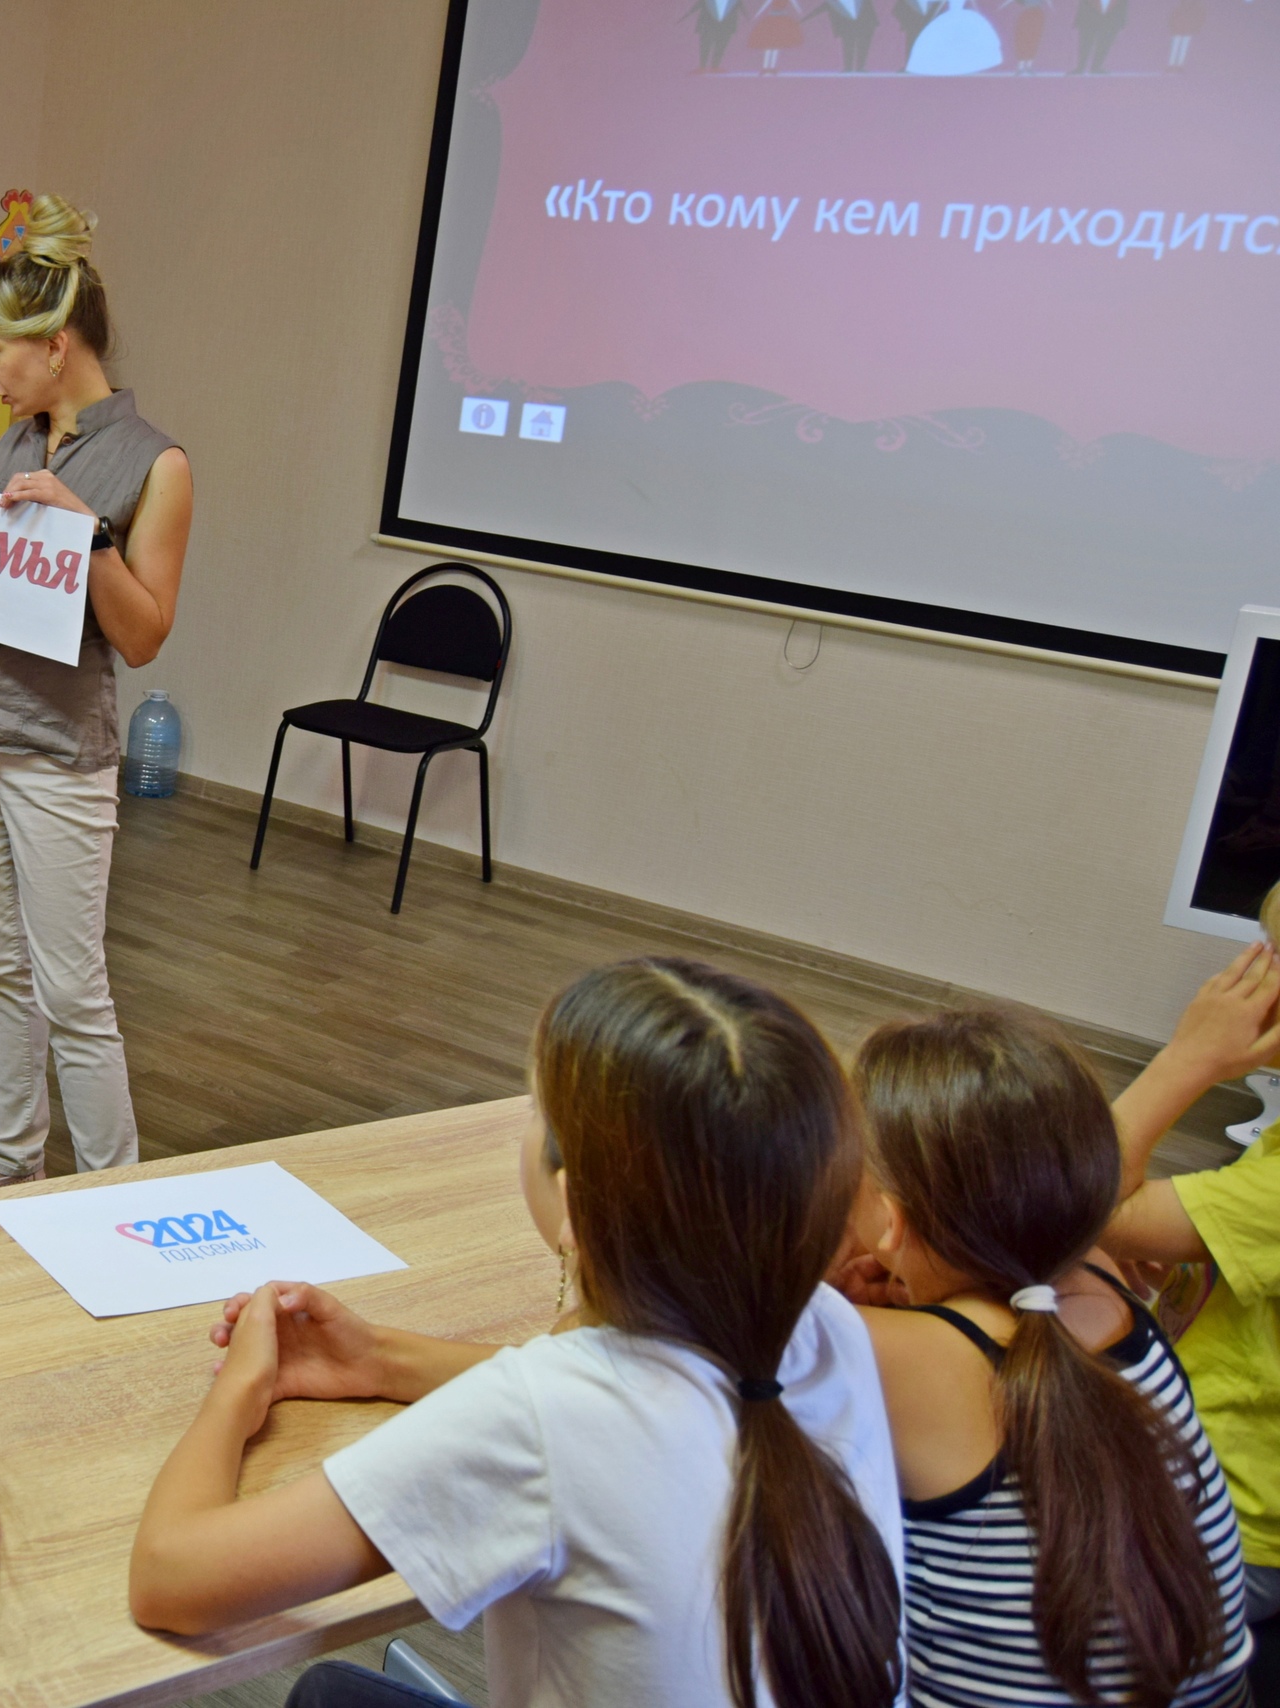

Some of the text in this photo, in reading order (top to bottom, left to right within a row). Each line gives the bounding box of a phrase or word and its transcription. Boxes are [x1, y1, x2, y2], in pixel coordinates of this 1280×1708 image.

[544, 179, 1280, 260] «Кто кому кем приходитс
[133, 1209, 251, 1248] 2024
[159, 1246, 204, 1264] ГОД
